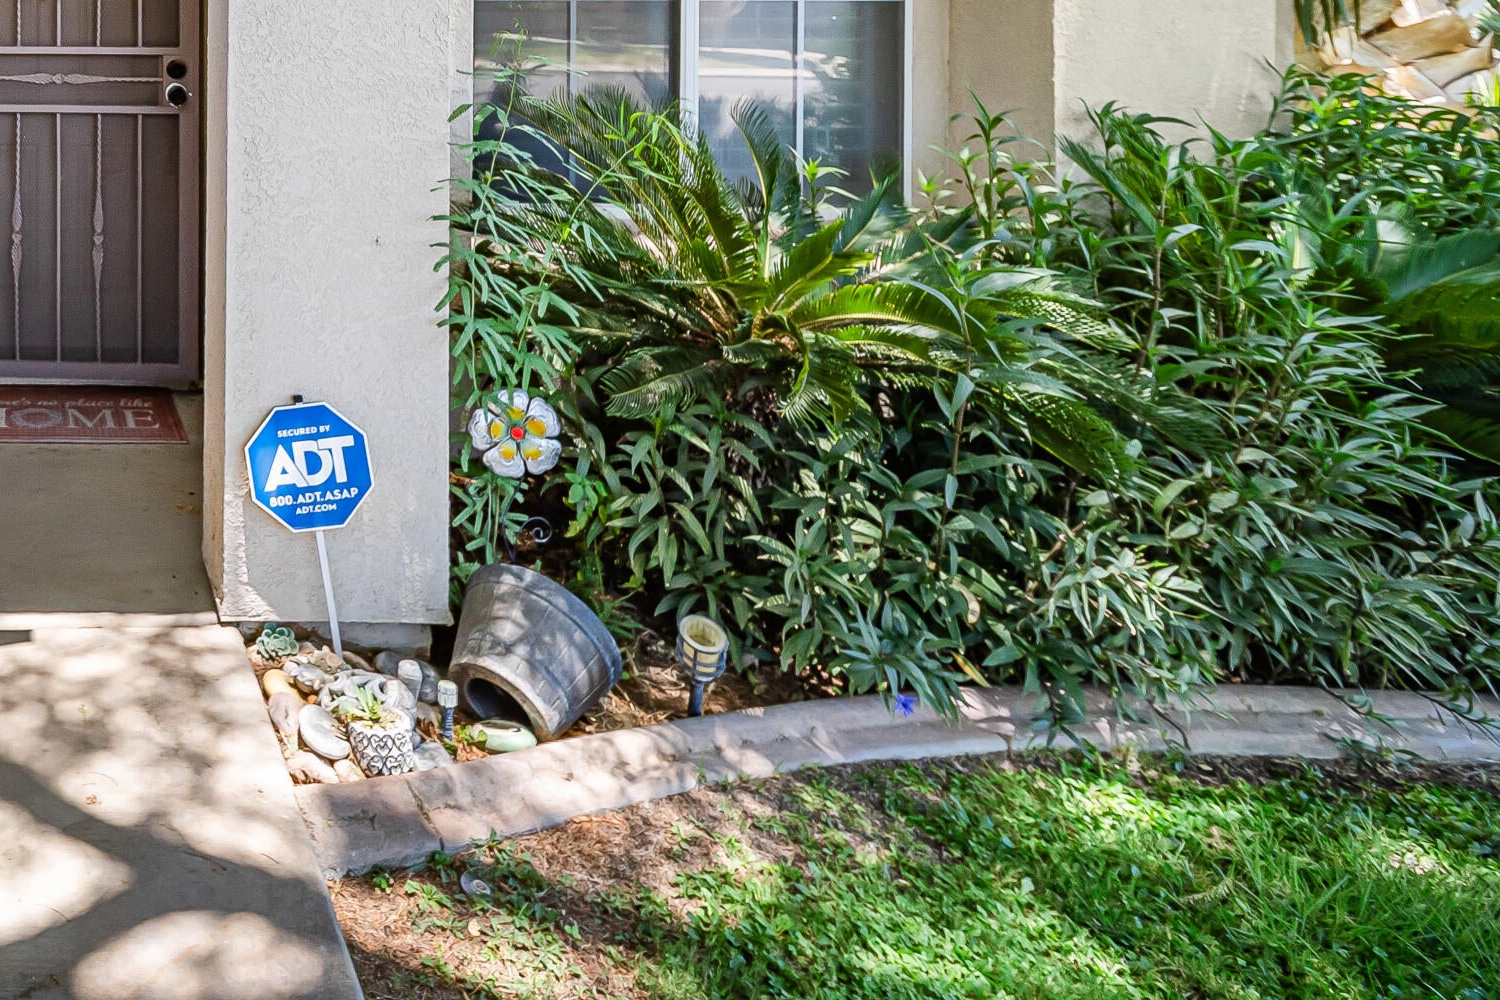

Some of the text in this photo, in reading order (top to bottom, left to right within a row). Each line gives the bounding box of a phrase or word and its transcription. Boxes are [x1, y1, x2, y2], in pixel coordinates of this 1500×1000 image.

[277, 424, 331, 438] SECURED BY
[264, 434, 355, 493] ADT
[269, 487, 359, 508] 800.ADT.ASAP
[295, 503, 337, 515] ADT.COM
